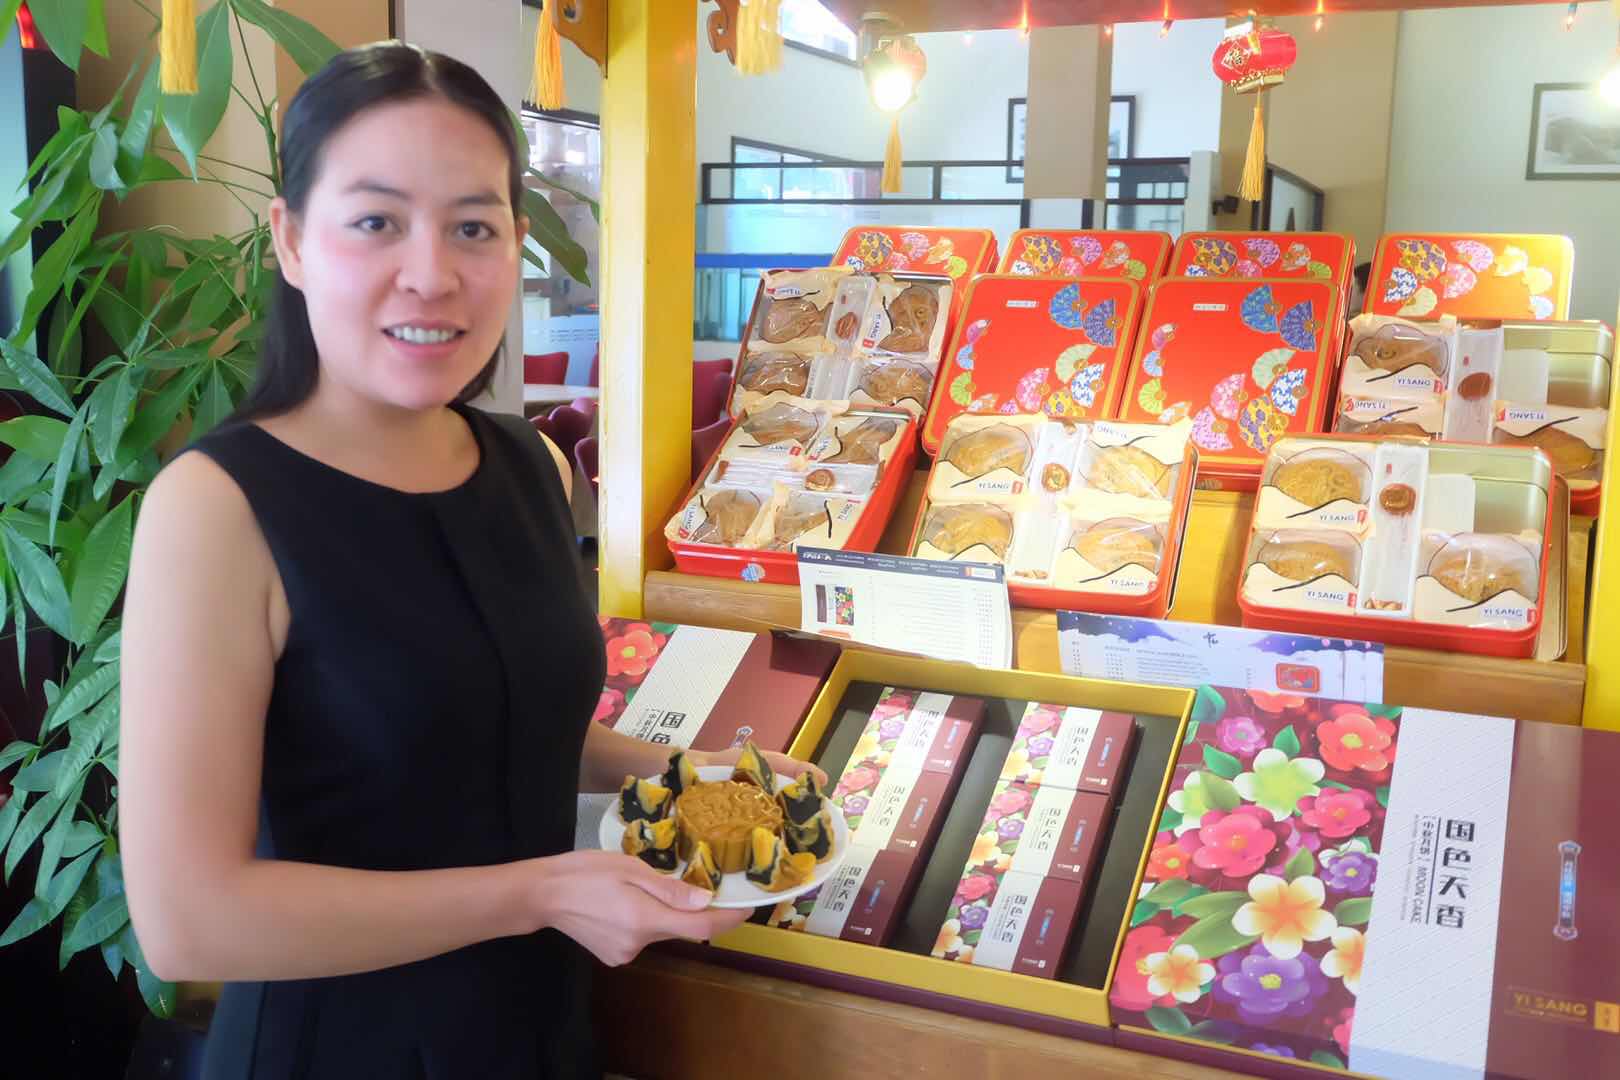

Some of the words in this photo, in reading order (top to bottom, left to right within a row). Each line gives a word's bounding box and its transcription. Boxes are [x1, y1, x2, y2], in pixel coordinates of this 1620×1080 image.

[1406, 378, 1431, 387] SANG
[987, 482, 1009, 490] SANG
[1330, 514, 1355, 522] SANG
[1317, 591, 1344, 601] SANG
[1484, 608, 1493, 616] YI
[1494, 608, 1523, 617] SANG
[1436, 819, 1475, 929] 国色天香
[1414, 866, 1428, 896] MOON
[1410, 898, 1424, 923] CAKE
[1514, 991, 1530, 1008] YI
[1535, 996, 1588, 1017] SANG
